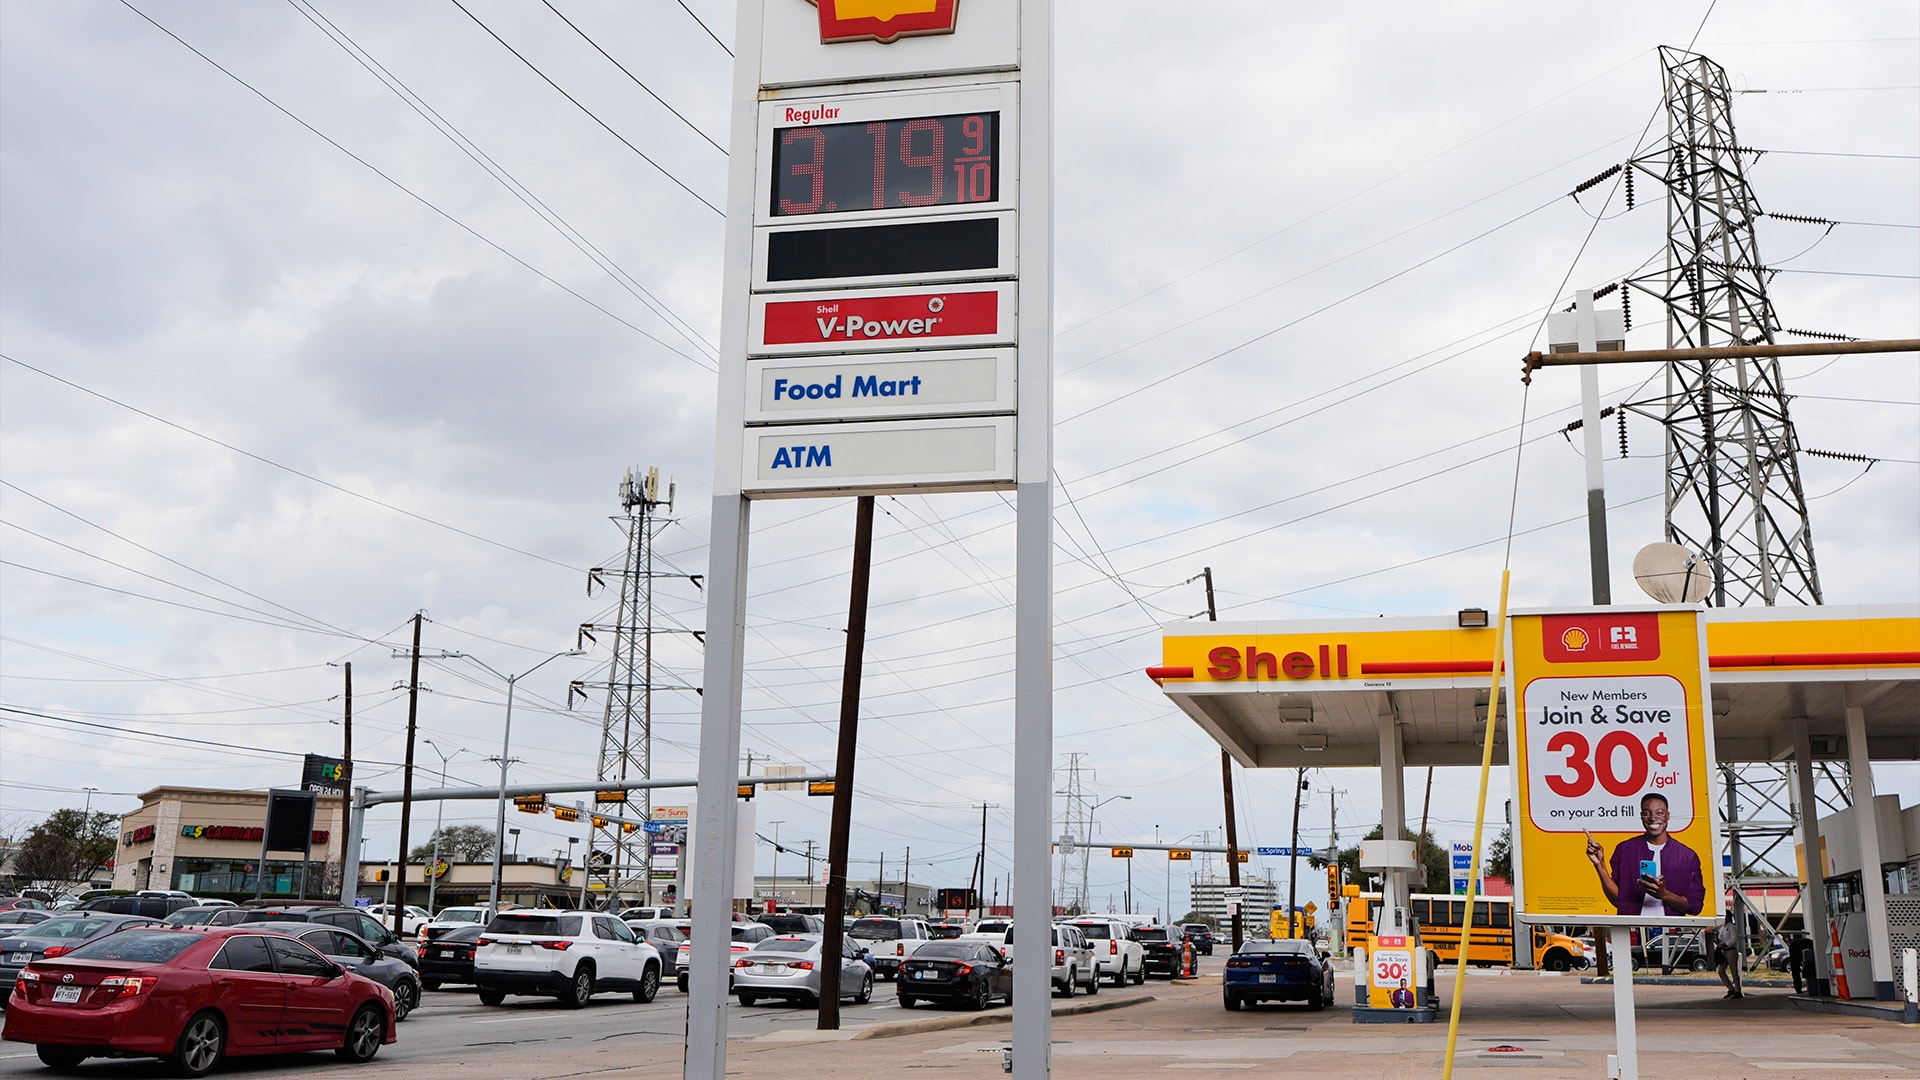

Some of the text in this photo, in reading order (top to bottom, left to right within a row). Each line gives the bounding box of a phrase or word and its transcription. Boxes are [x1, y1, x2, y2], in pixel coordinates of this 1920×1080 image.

[785, 104, 841, 124] Regular
[962, 115, 984, 155] 9
[779, 118, 945, 215] 3.19
[954, 162, 991, 203] 10
[816, 304, 839, 314] Shell
[816, 315, 938, 339] V-Power
[773, 375, 922, 400] Food Mart
[771, 445, 832, 469] ATM
[1207, 644, 1349, 679] Shell
[1560, 689, 1648, 701] New Members
[1539, 704, 1671, 725] Join & Save
[324, 786, 331, 796] 24
[668, 809, 688, 818] Sunny
[1550, 805, 1634, 820] on your 3rd fill
[205, 825, 264, 840] CAMBIAM
[1453, 844, 1473, 852] Mob
